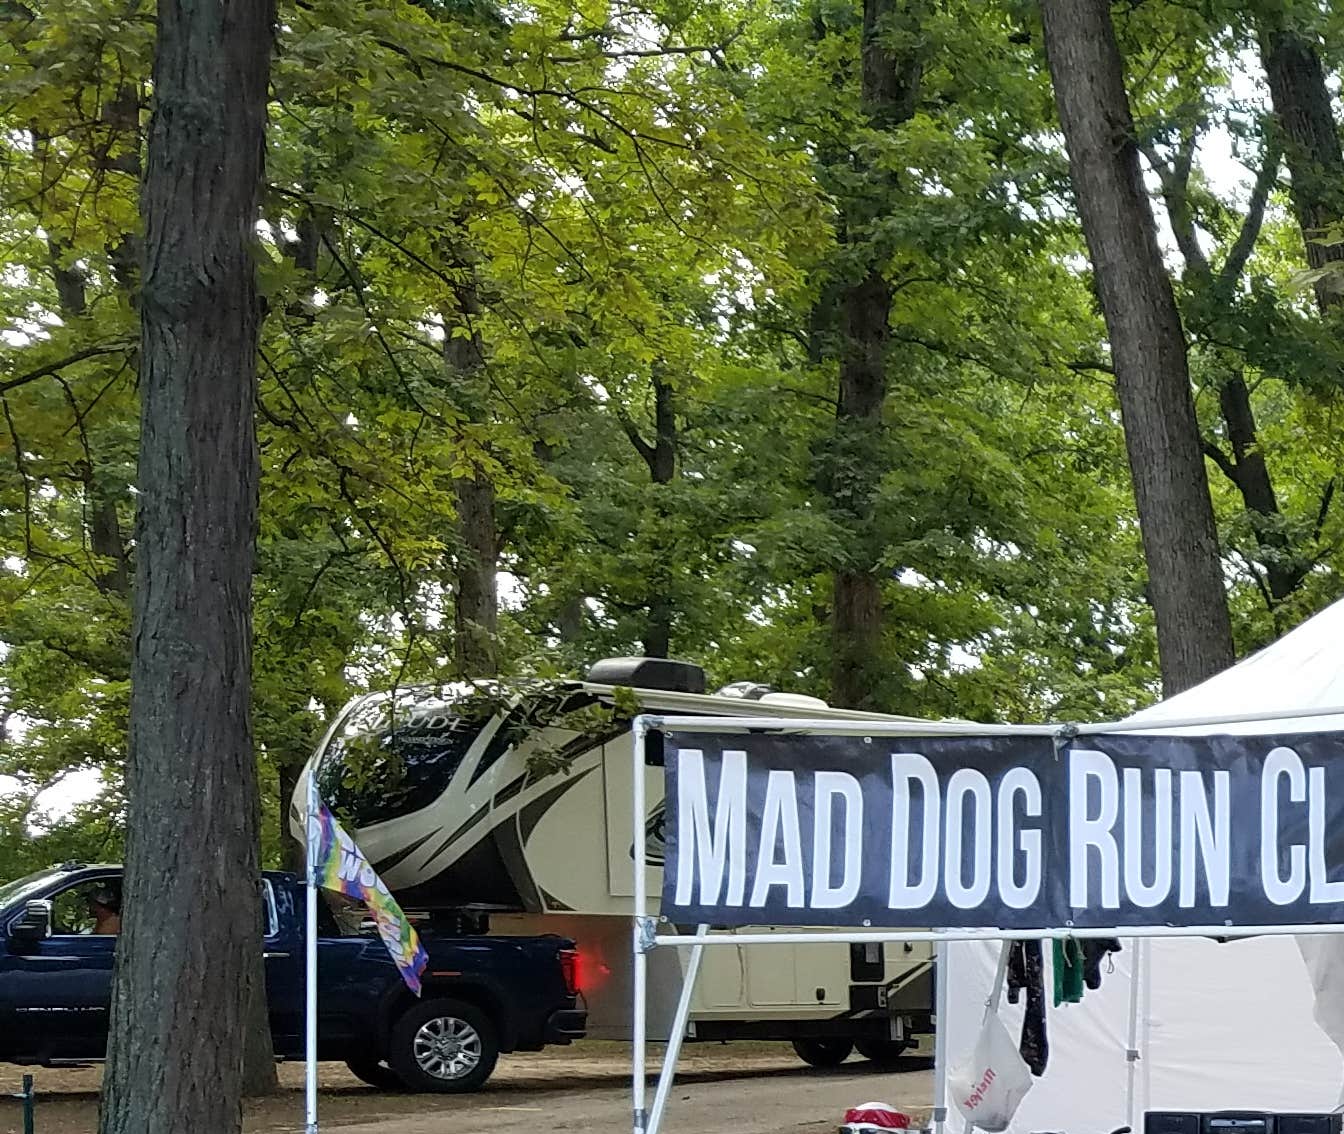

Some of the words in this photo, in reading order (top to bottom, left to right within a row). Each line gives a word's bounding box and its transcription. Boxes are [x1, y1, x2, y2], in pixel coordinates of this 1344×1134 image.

[675, 748, 863, 908] MAD
[888, 753, 1042, 909] DOG
[1069, 749, 1230, 908] RUN
